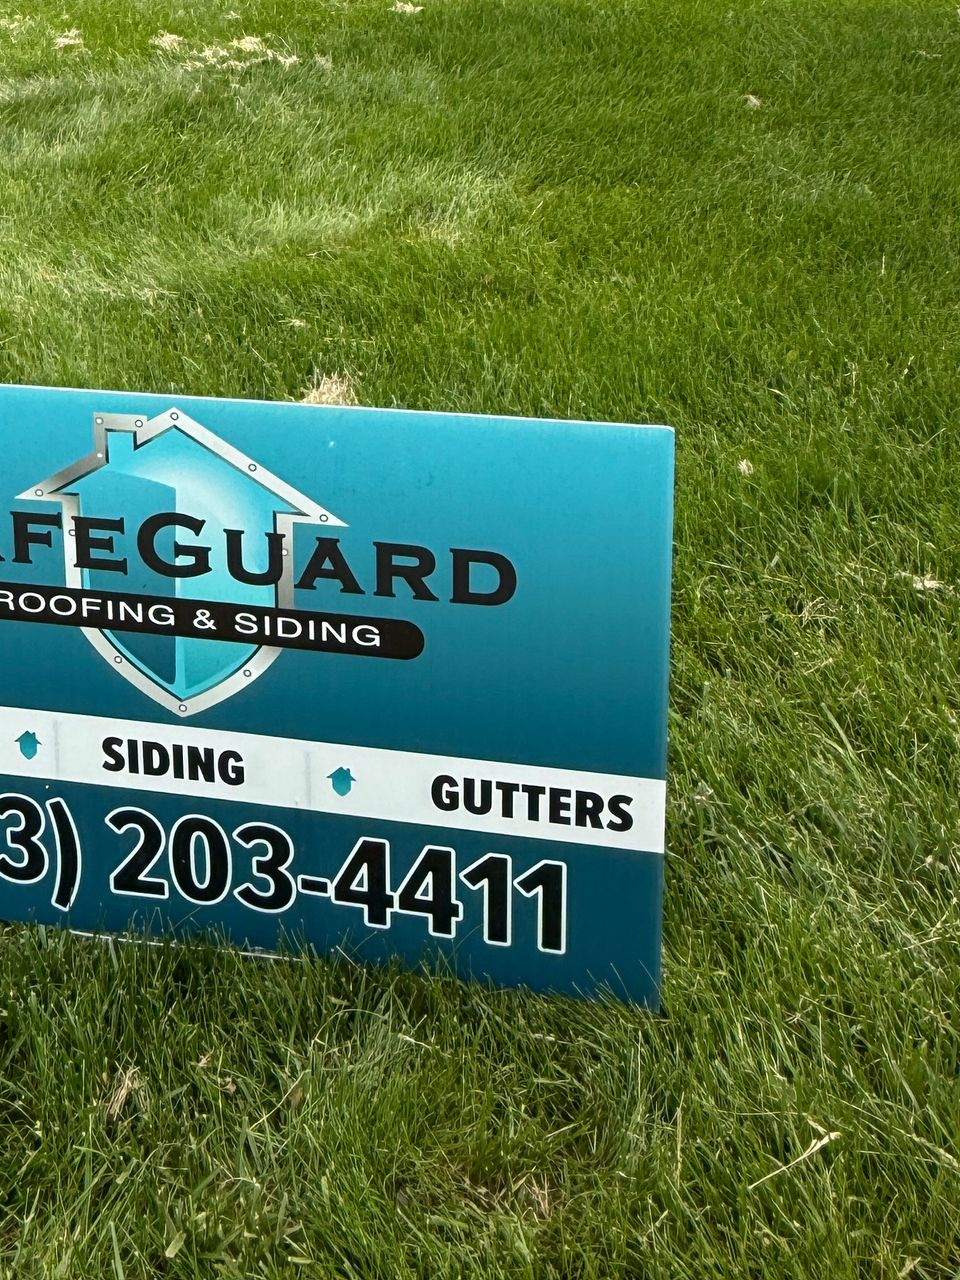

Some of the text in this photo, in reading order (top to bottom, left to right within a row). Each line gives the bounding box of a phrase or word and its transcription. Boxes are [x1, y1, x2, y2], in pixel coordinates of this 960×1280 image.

[192, 608, 218, 631] &
[234, 612, 382, 648] SIDING
[101, 736, 246, 786] SIDING
[430, 775, 634, 832] GUTTERS
[105, 806, 568, 955] 203-4411
